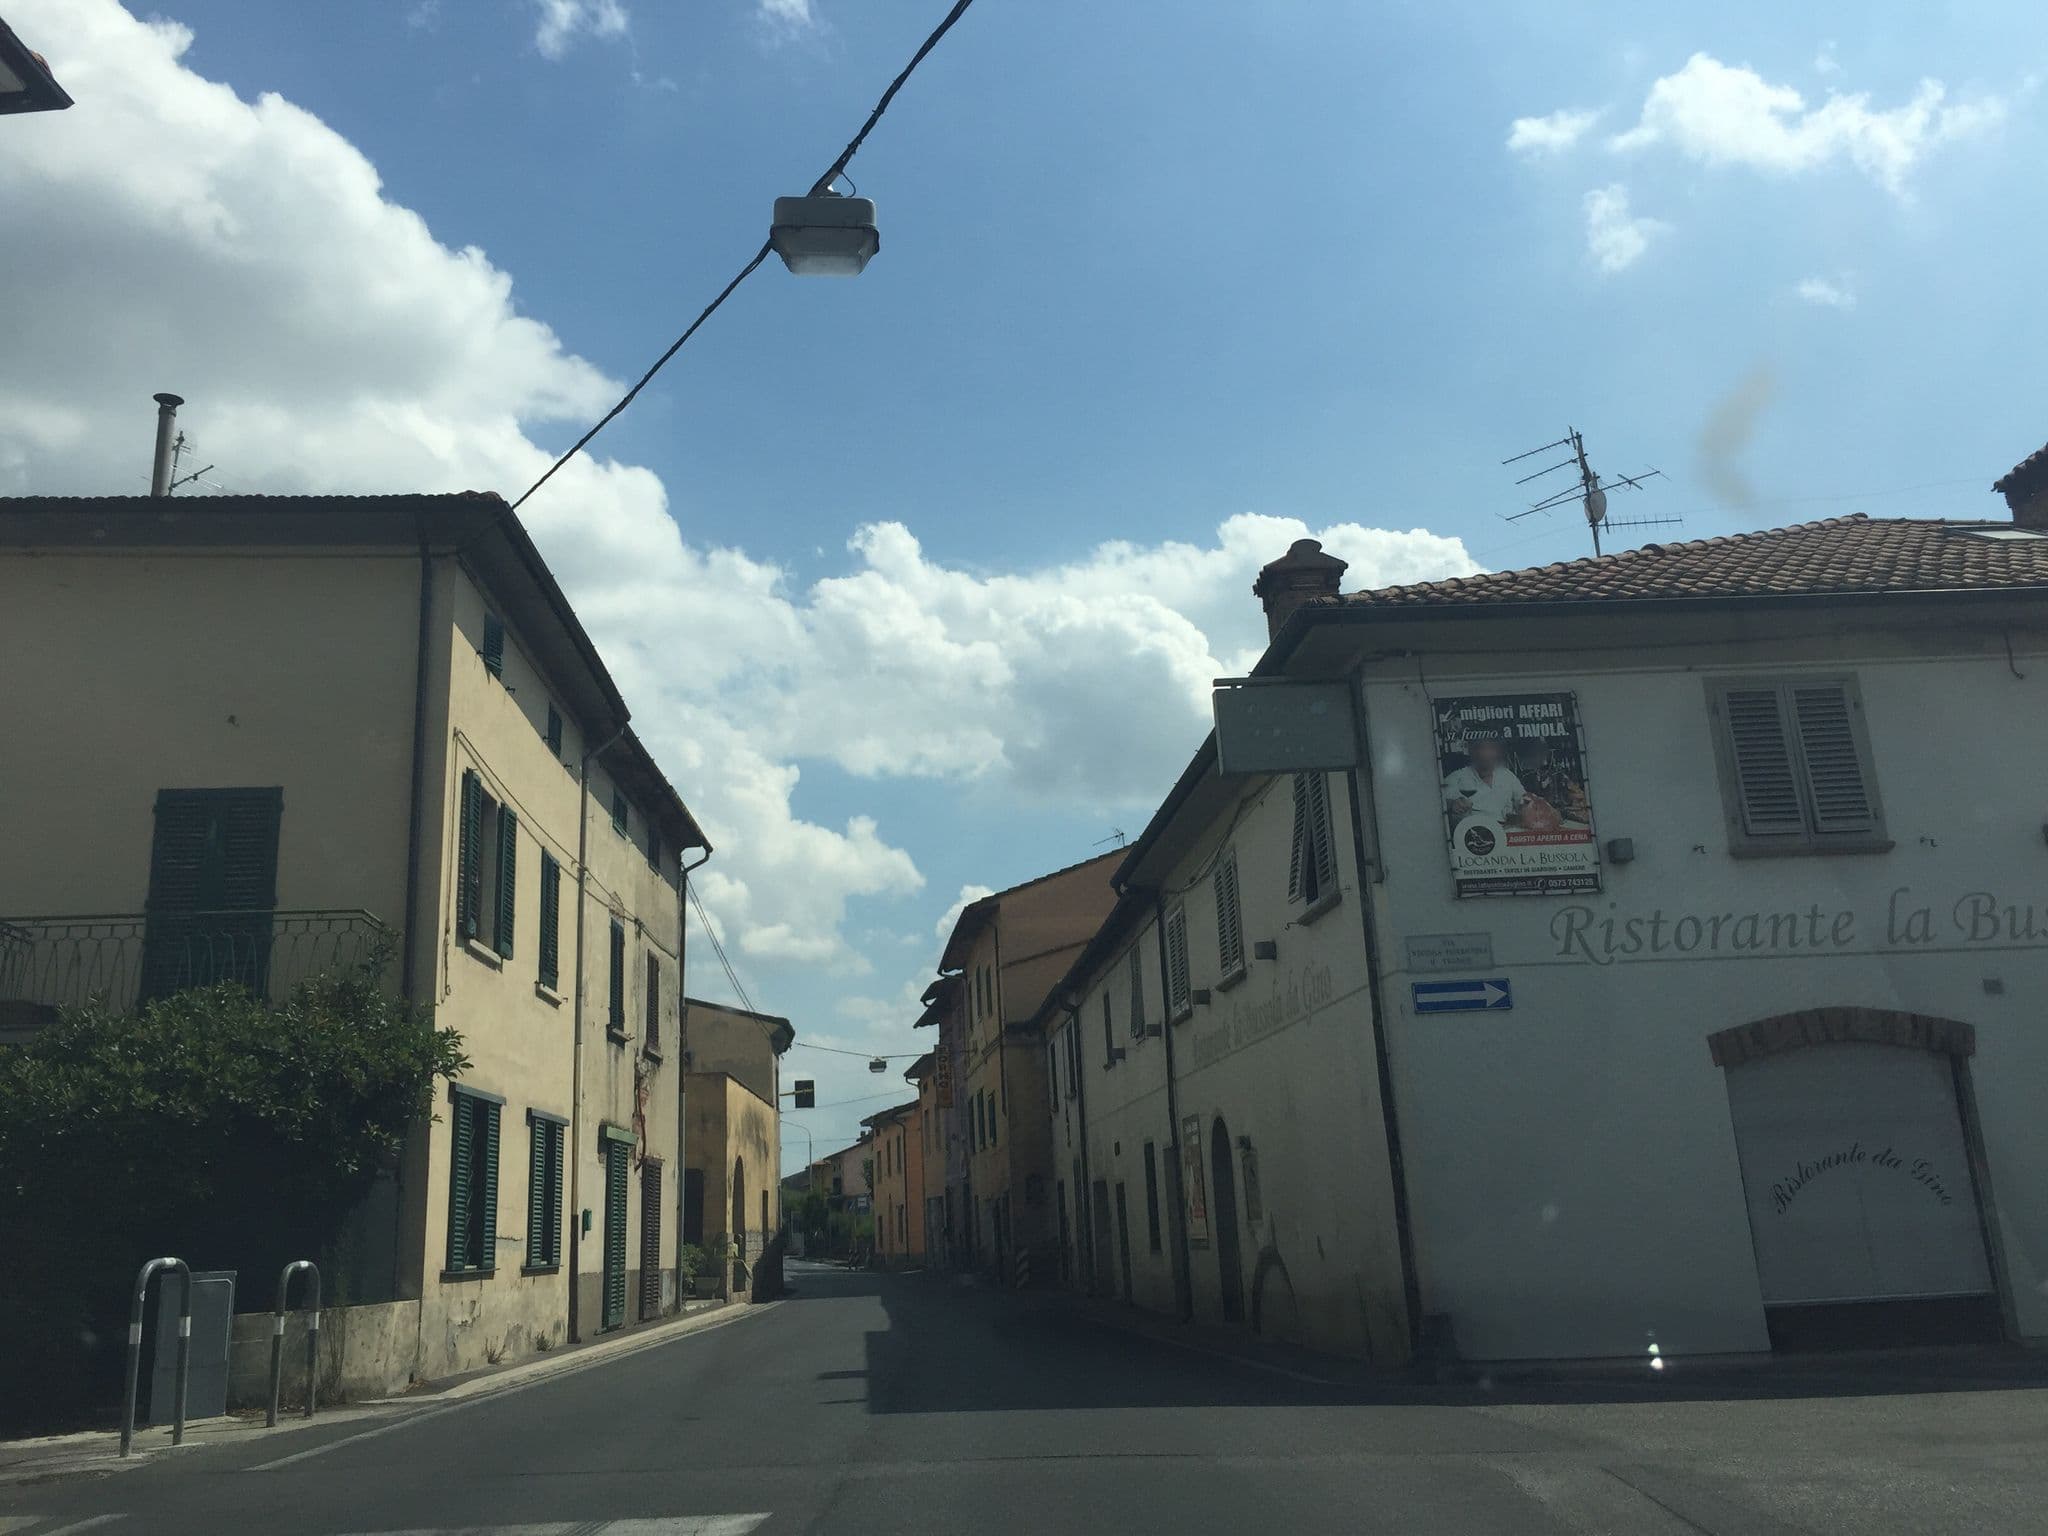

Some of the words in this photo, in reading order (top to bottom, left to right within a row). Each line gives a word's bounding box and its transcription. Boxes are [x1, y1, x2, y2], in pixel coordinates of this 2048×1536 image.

[1460, 704, 1514, 721] migliori
[1519, 703, 1563, 718] AFFARI
[1461, 727, 1498, 741] fanno
[1503, 726, 1513, 738] a
[1516, 722, 1570, 738] TAVOLA.
[1509, 835, 1535, 843] AGOSTO
[1537, 834, 1561, 842] APERTO
[1570, 833, 1589, 841] CENA
[1550, 902, 1856, 965] Ristorante
[1886, 887, 1938, 945] la
[1771, 1141, 1866, 1215] Ristorante
[1871, 1147, 1904, 1169] da
[1910, 1157, 1952, 1207] Gino
